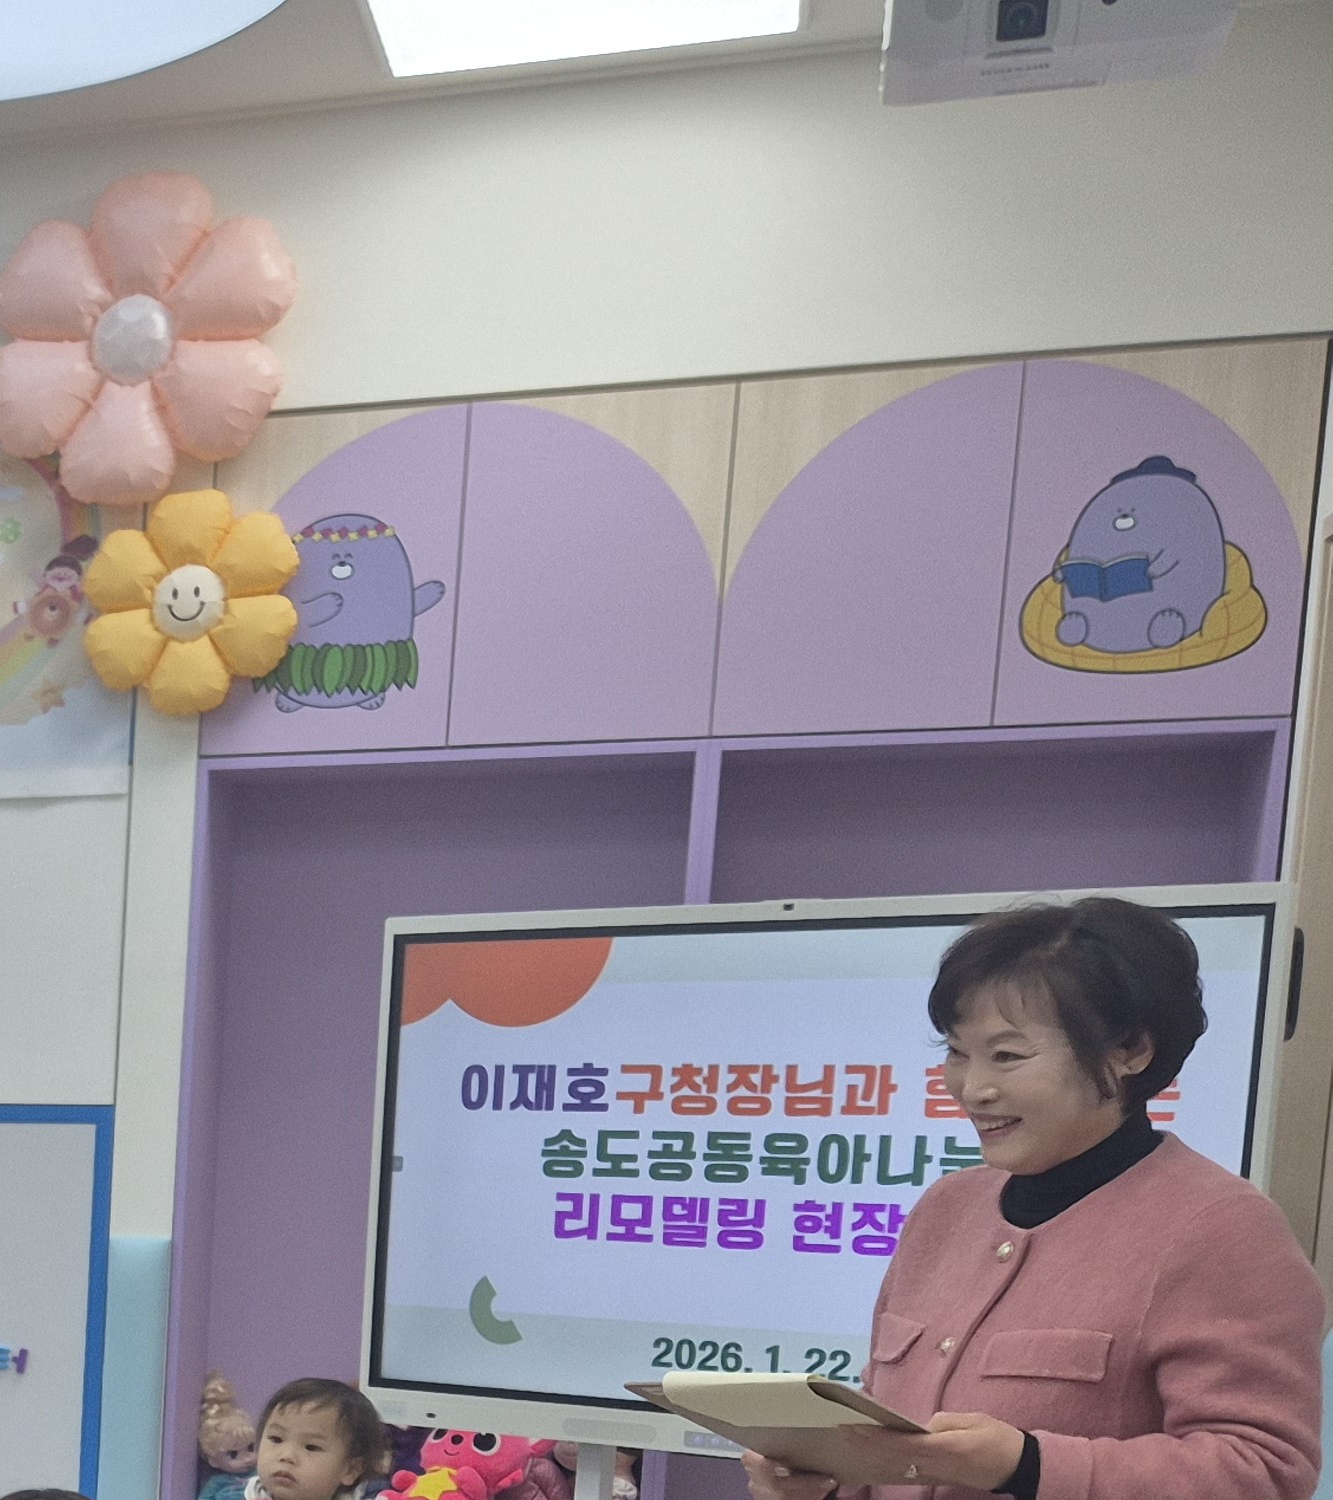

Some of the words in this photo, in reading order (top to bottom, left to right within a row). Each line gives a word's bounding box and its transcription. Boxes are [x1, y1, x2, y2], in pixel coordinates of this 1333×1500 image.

[460, 1062, 898, 1117] 이재호구청장님과
[553, 1191, 767, 1251] 리모델링
[651, 1336, 753, 1373] 2026.
